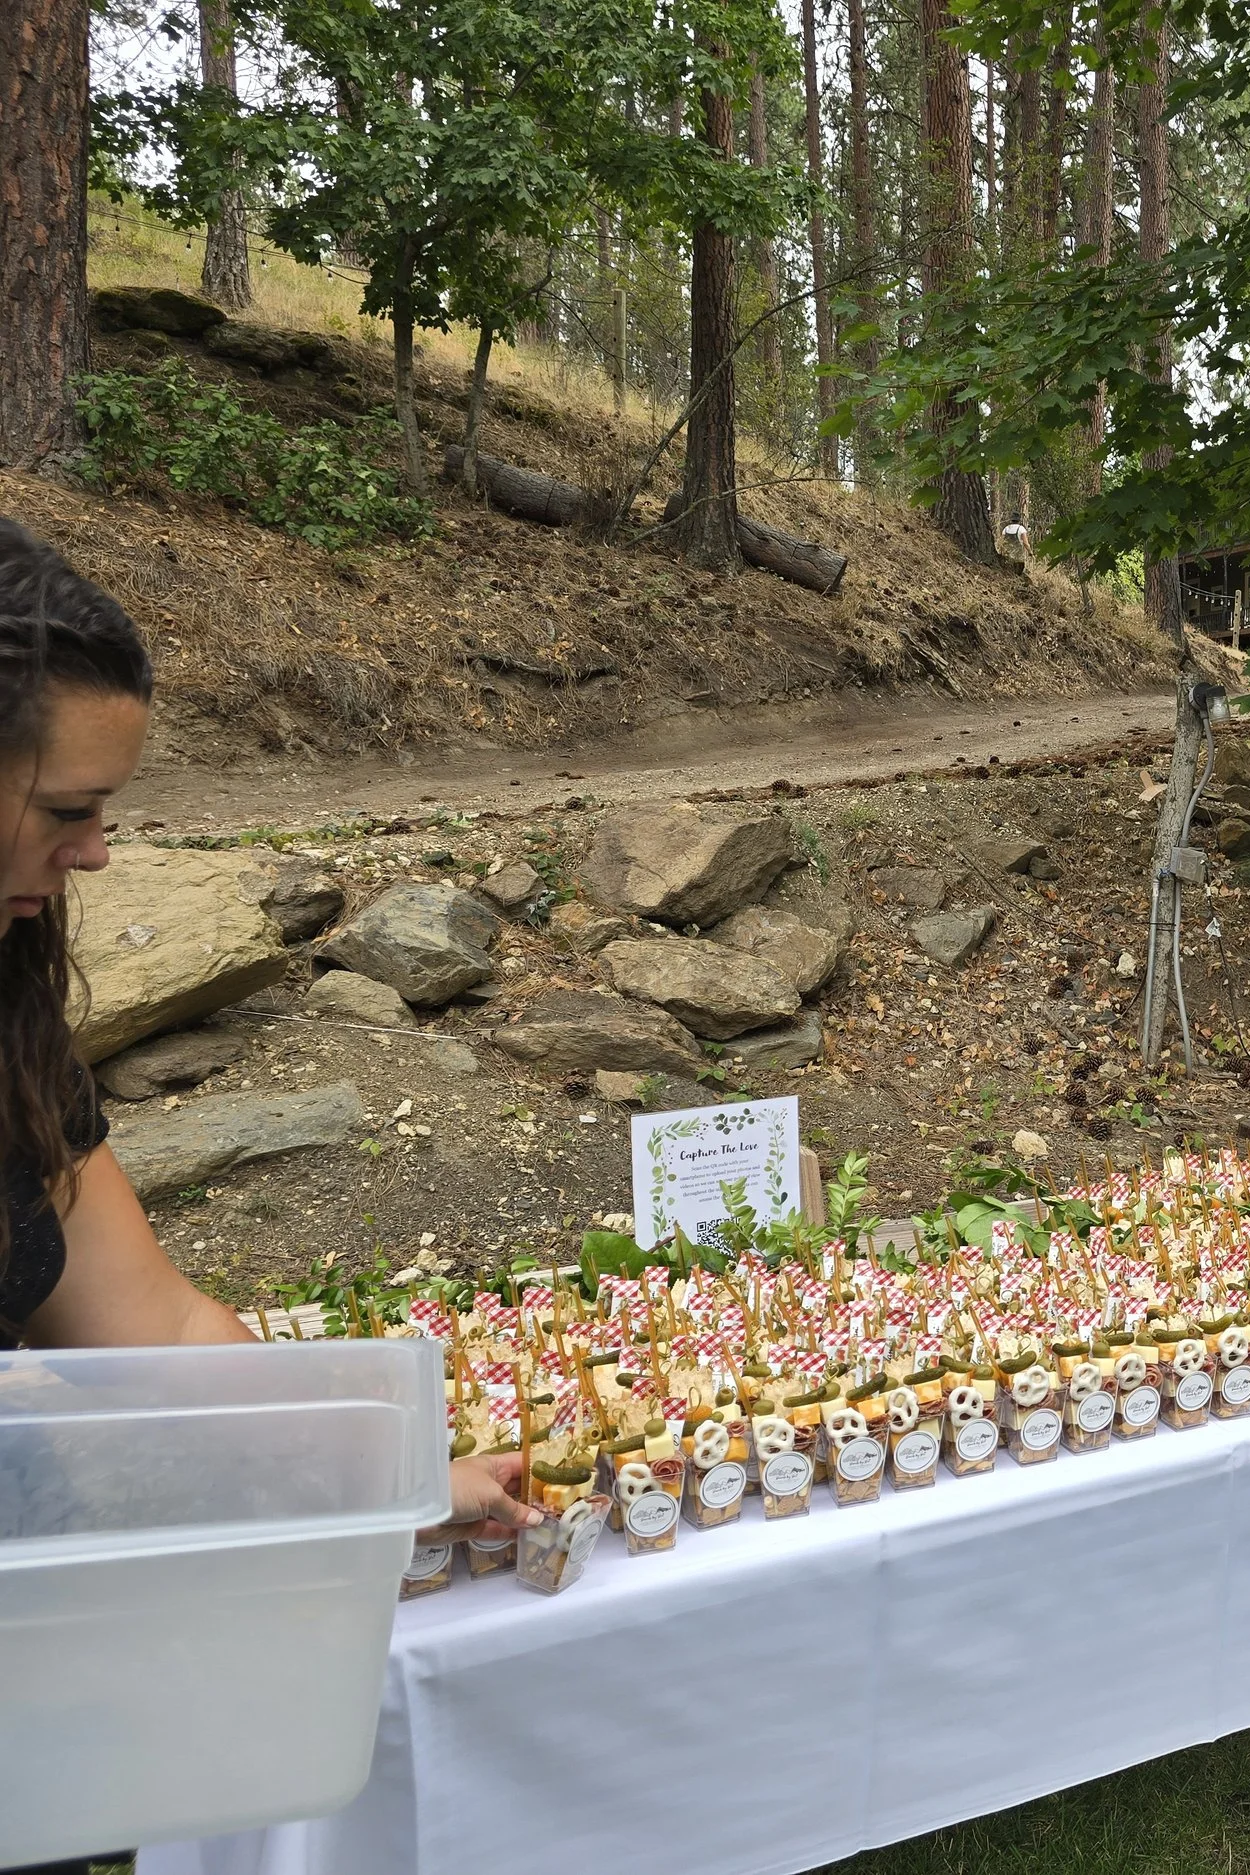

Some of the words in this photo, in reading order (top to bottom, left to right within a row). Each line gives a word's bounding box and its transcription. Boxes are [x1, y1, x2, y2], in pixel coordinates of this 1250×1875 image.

[680, 1149, 718, 1161] Capture
[721, 1144, 737, 1154] The
[740, 1142, 758, 1151] Love
